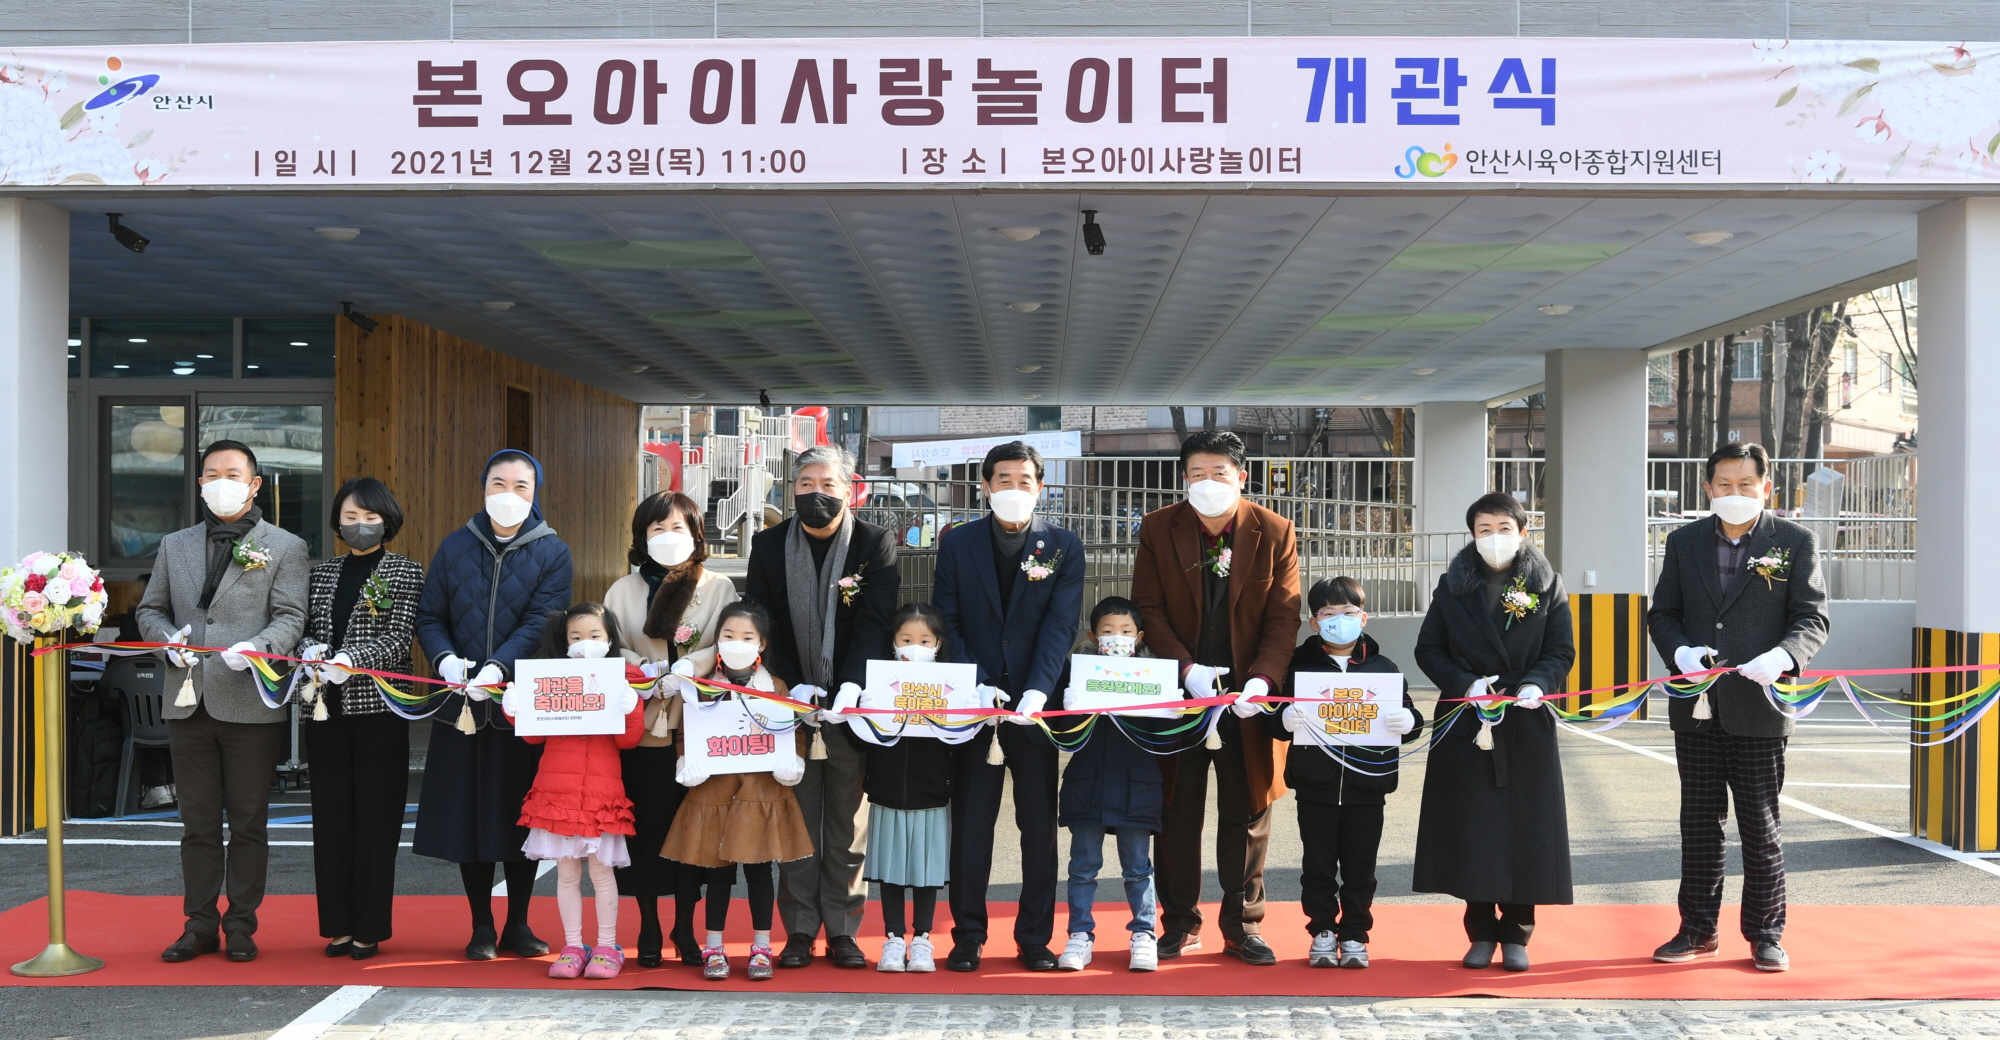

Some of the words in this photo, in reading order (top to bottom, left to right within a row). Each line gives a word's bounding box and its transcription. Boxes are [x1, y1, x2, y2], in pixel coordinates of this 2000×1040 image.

[413, 58, 1228, 127] 본오아이사랑놀이터
[1297, 57, 1557, 126] 개관식
[152, 95, 213, 110] 안산시
[390, 149, 493, 175] 2021년
[510, 149, 571, 175] 12월
[587, 147, 705, 177] 23일(목)
[721, 150, 806, 174] 11:00
[1041, 147, 1301, 175] 본오아이사랑놀이터
[1466, 149, 1721, 176] 안산시육아종합지원센터
[533, 676, 584, 696] 개관을
[901, 682, 942, 698] 안산시
[1333, 688, 1364, 704] 본오
[533, 693, 606, 713] 축하해요!
[893, 695, 948, 714] 육아종합
[1318, 703, 1379, 720] 아이사랑
[1325, 719, 1371, 735] 놀이터
[706, 733, 776, 757] 화이팅!
